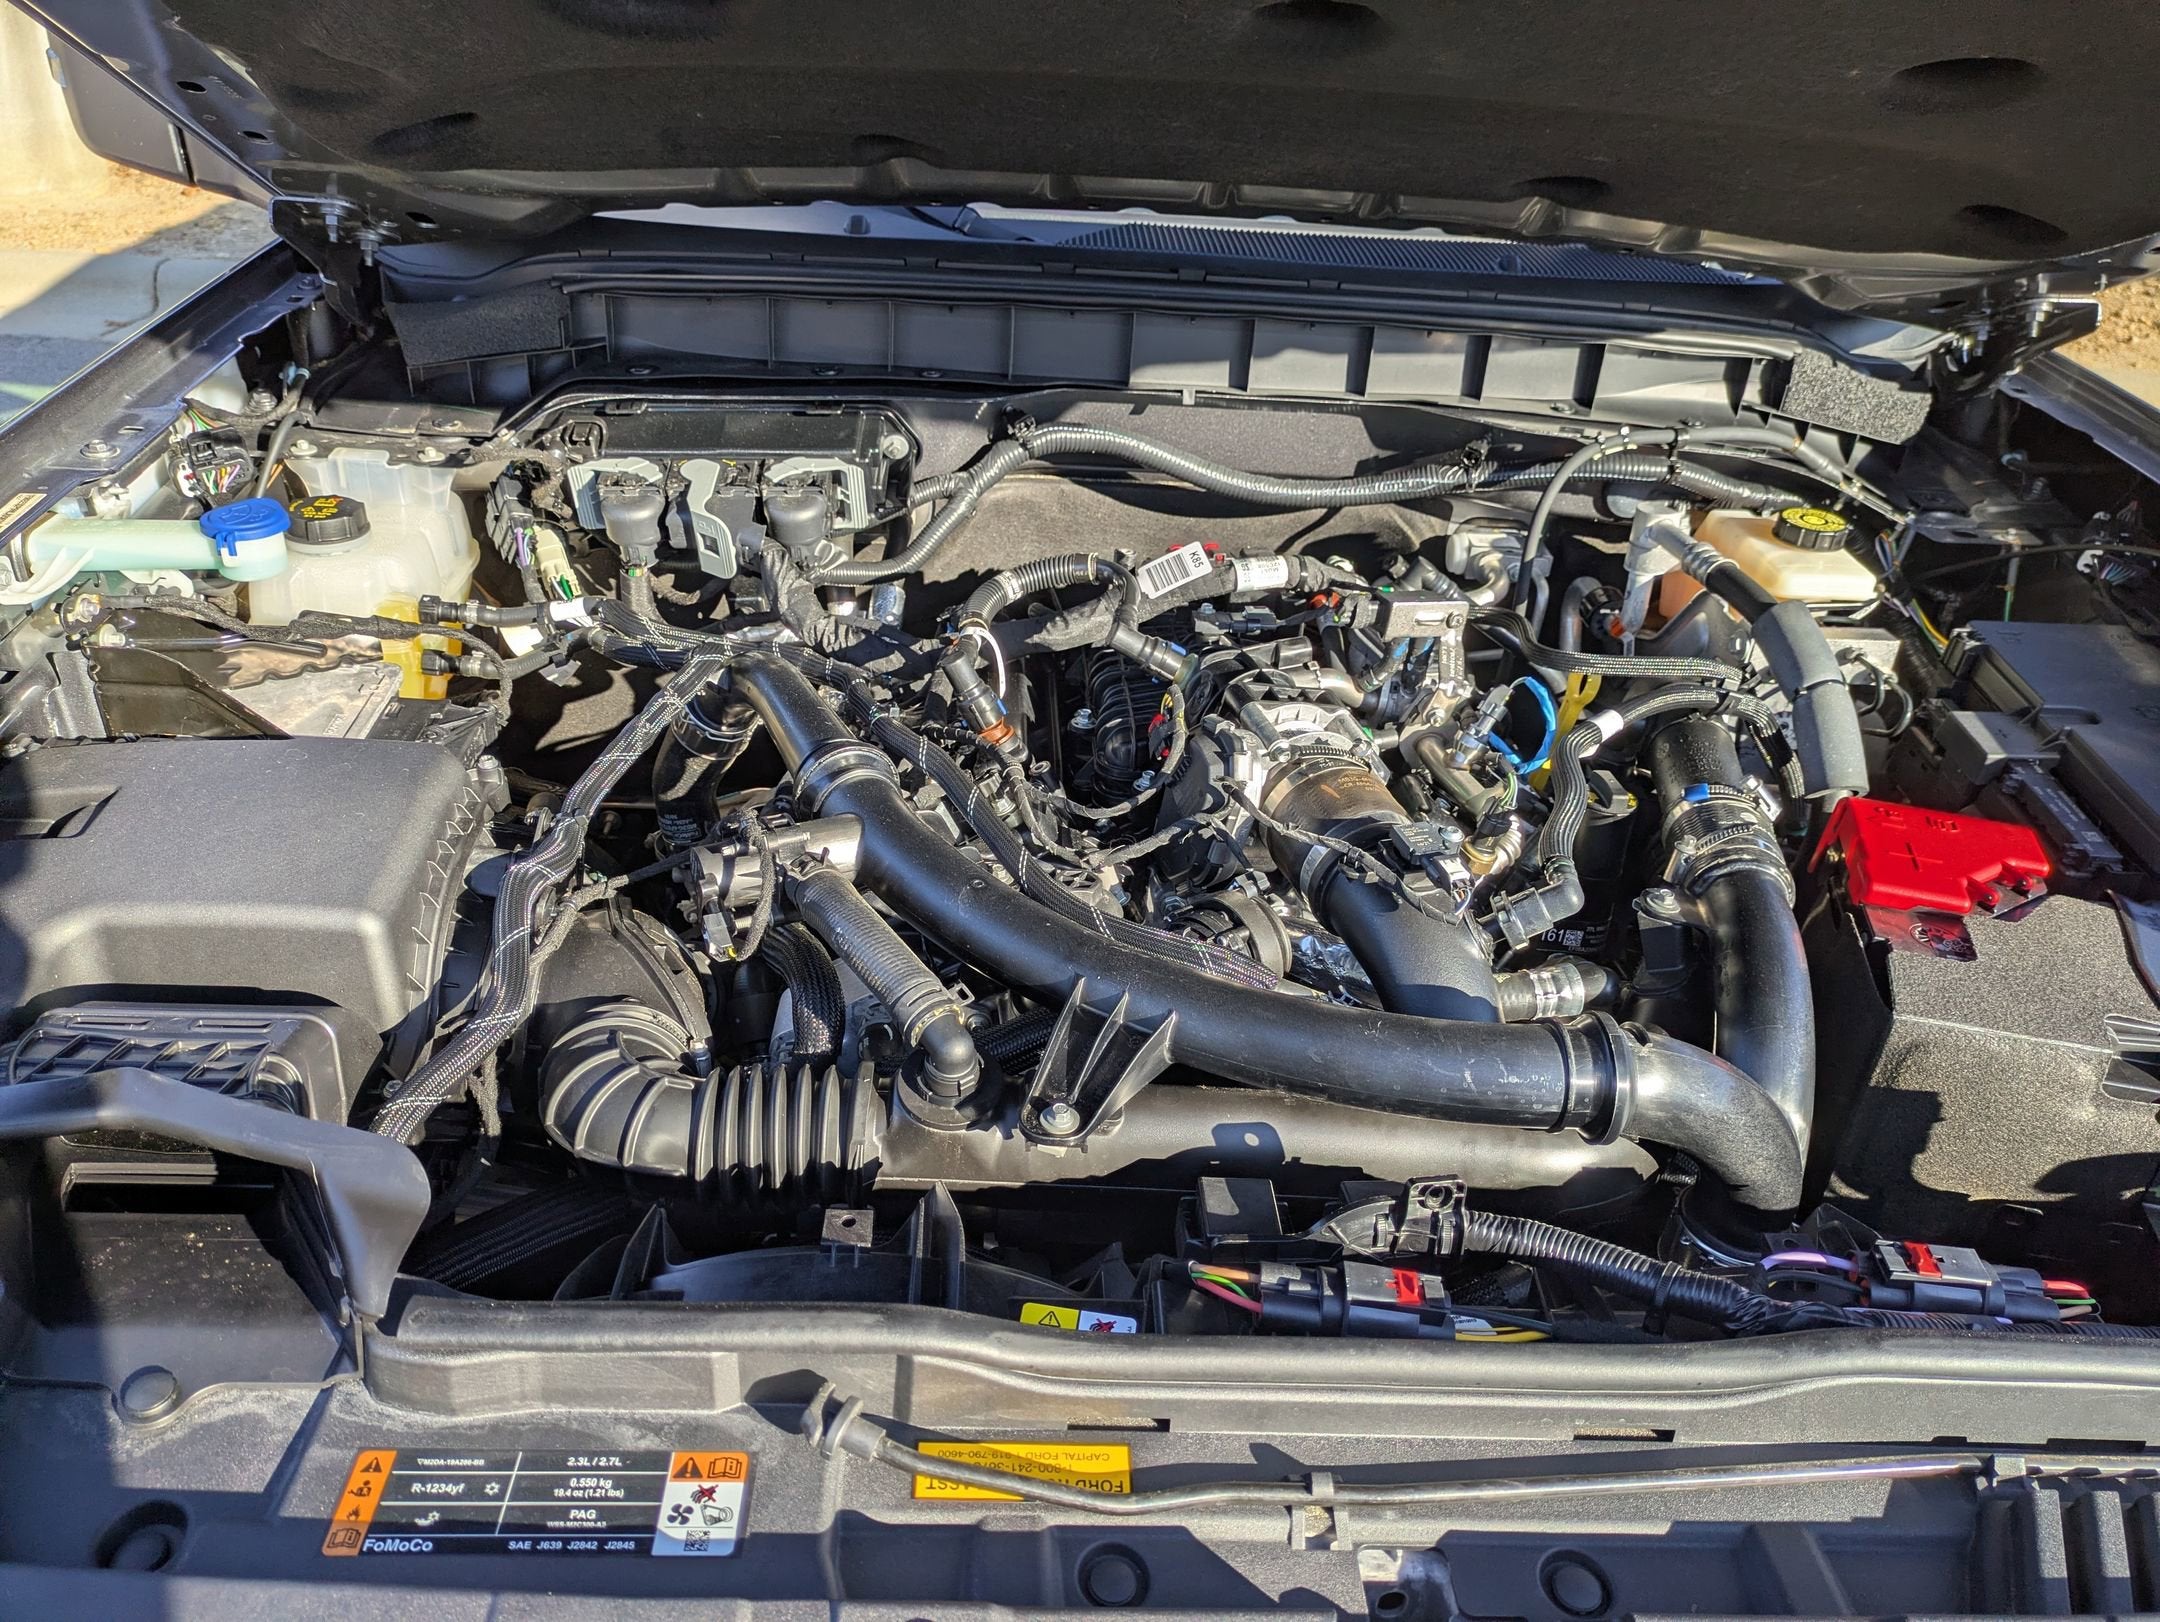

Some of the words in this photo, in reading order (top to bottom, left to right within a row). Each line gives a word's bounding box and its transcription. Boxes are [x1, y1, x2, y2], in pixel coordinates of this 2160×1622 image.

[1188, 550, 1204, 568] K85
[937, 1449, 1020, 1460] 1-919-790-4600
[1025, 1451, 1059, 1461] FORD
[1061, 1452, 1110, 1462] CAPITAL
[567, 1457, 590, 1466] 2.3L
[599, 1457, 622, 1466] 2.7L
[570, 1477, 598, 1487] 0.550
[600, 1477, 612, 1489] kg
[410, 1482, 465, 1496] R-1234yf
[553, 1488, 572, 1497] 19.4
[573, 1489, 584, 1497] oz
[585, 1488, 606, 1499] (1.21
[607, 1488, 624, 1498] lbs)
[569, 1509, 597, 1519] PAG
[362, 1538, 433, 1552] FoMoCo
[508, 1541, 532, 1550] SAE
[537, 1541, 562, 1550] J639
[567, 1541, 598, 1550] J2842
[604, 1541, 636, 1550] J2845
